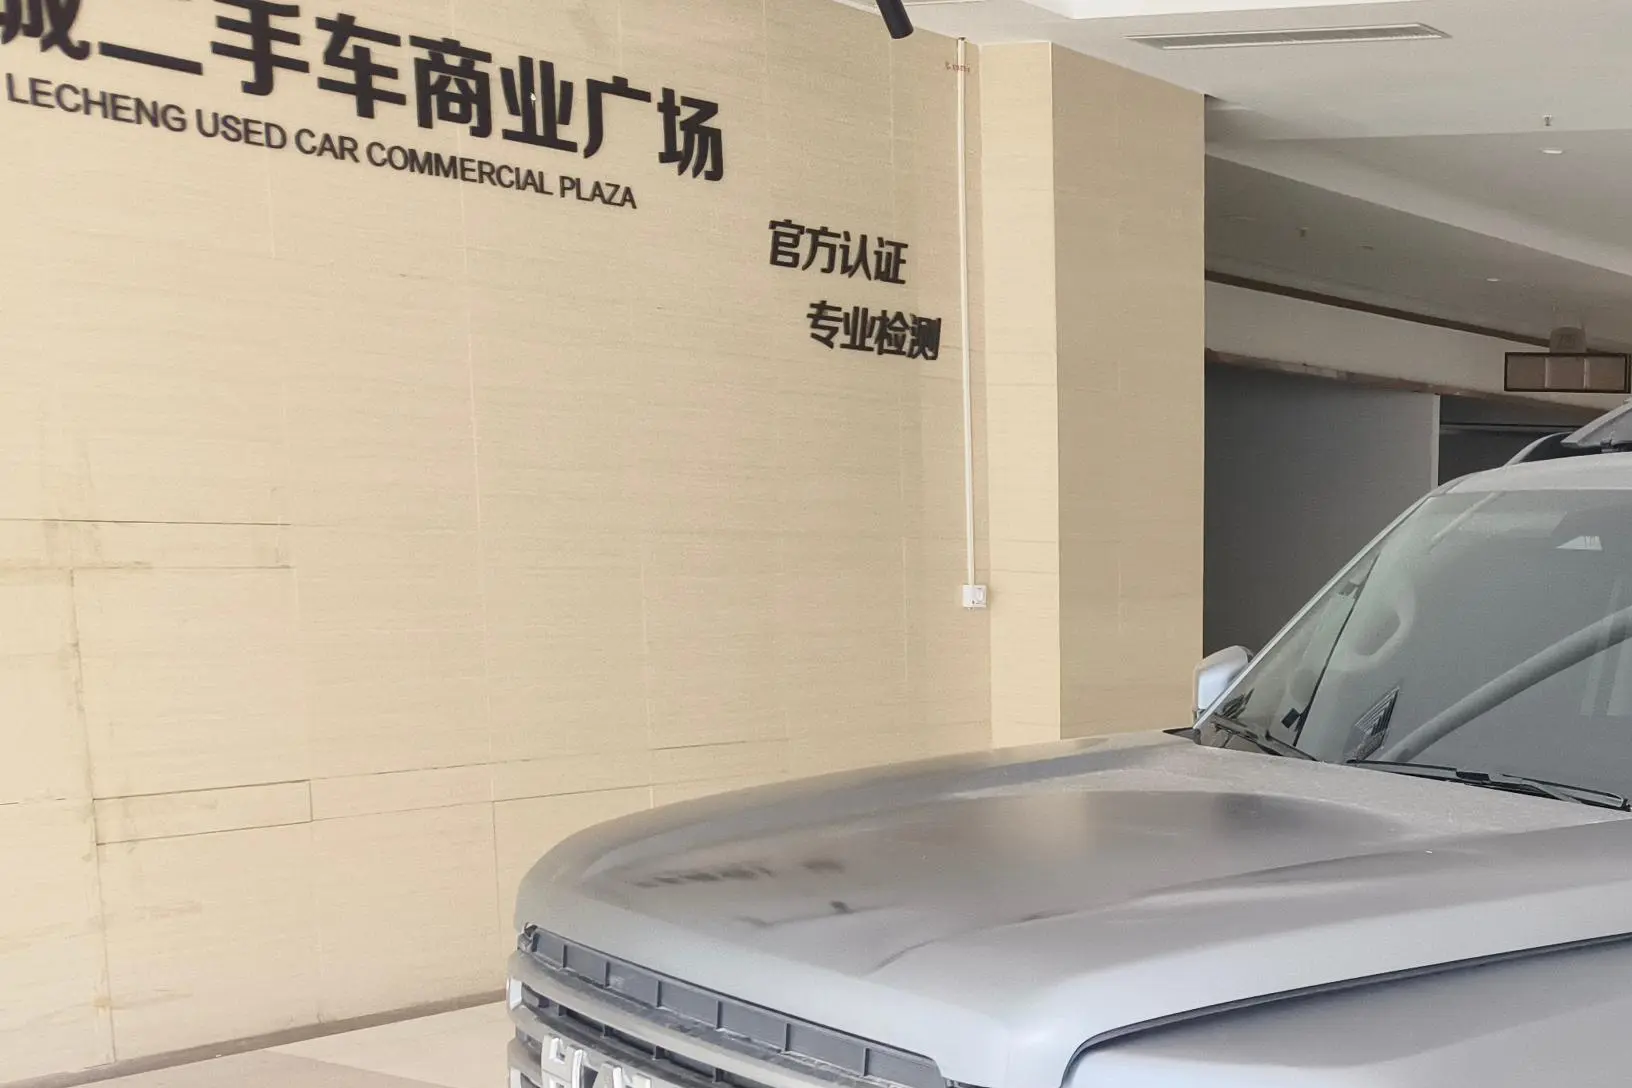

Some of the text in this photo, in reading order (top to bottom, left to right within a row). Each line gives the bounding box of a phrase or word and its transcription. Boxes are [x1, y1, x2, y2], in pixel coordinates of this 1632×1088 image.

[5, 73, 637, 209] LECHENG USED CAR COMMERCIAL PLAZA
[768, 219, 909, 284] 官方认证
[806, 300, 942, 360] 专业检测
